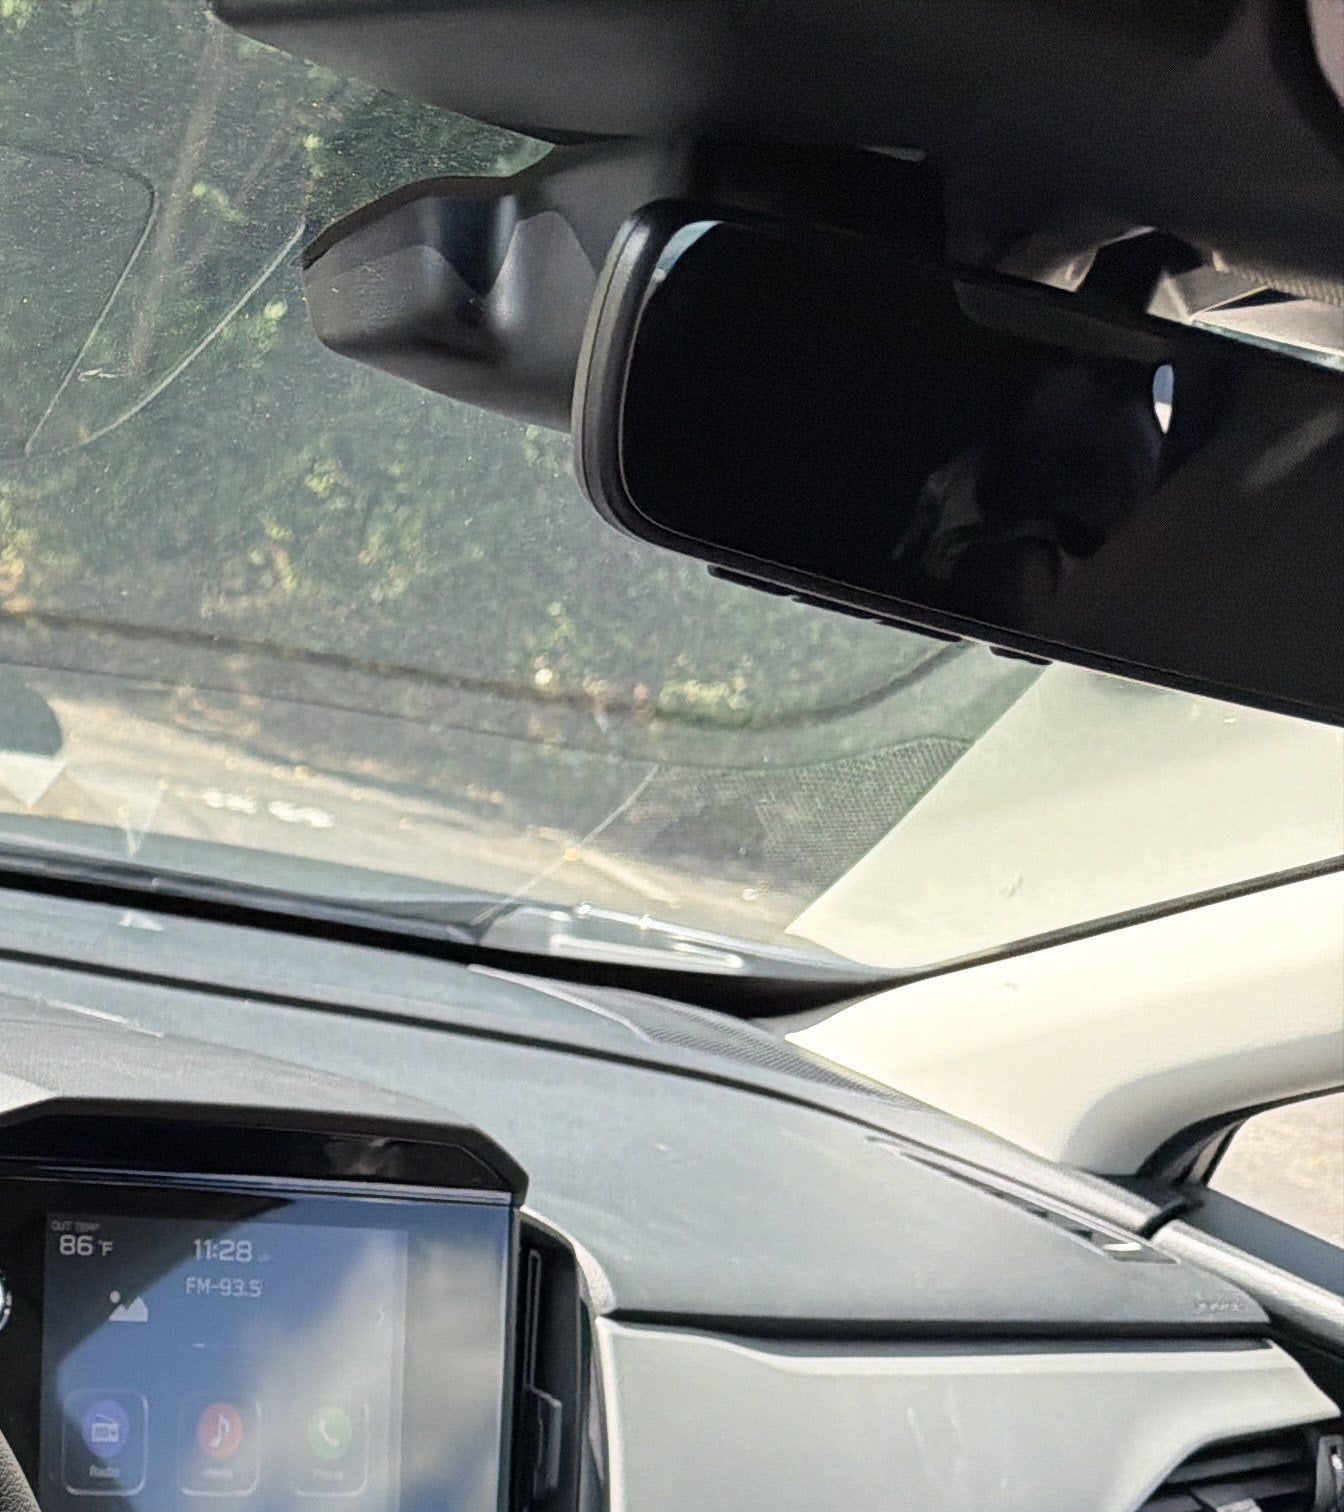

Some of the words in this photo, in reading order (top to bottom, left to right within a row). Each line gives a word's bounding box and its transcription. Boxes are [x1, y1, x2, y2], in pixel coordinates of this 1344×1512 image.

[59, 1234, 93, 1256] 86
[193, 1239, 252, 1262] 11:28
[185, 1275, 262, 1298] FM-93.5
